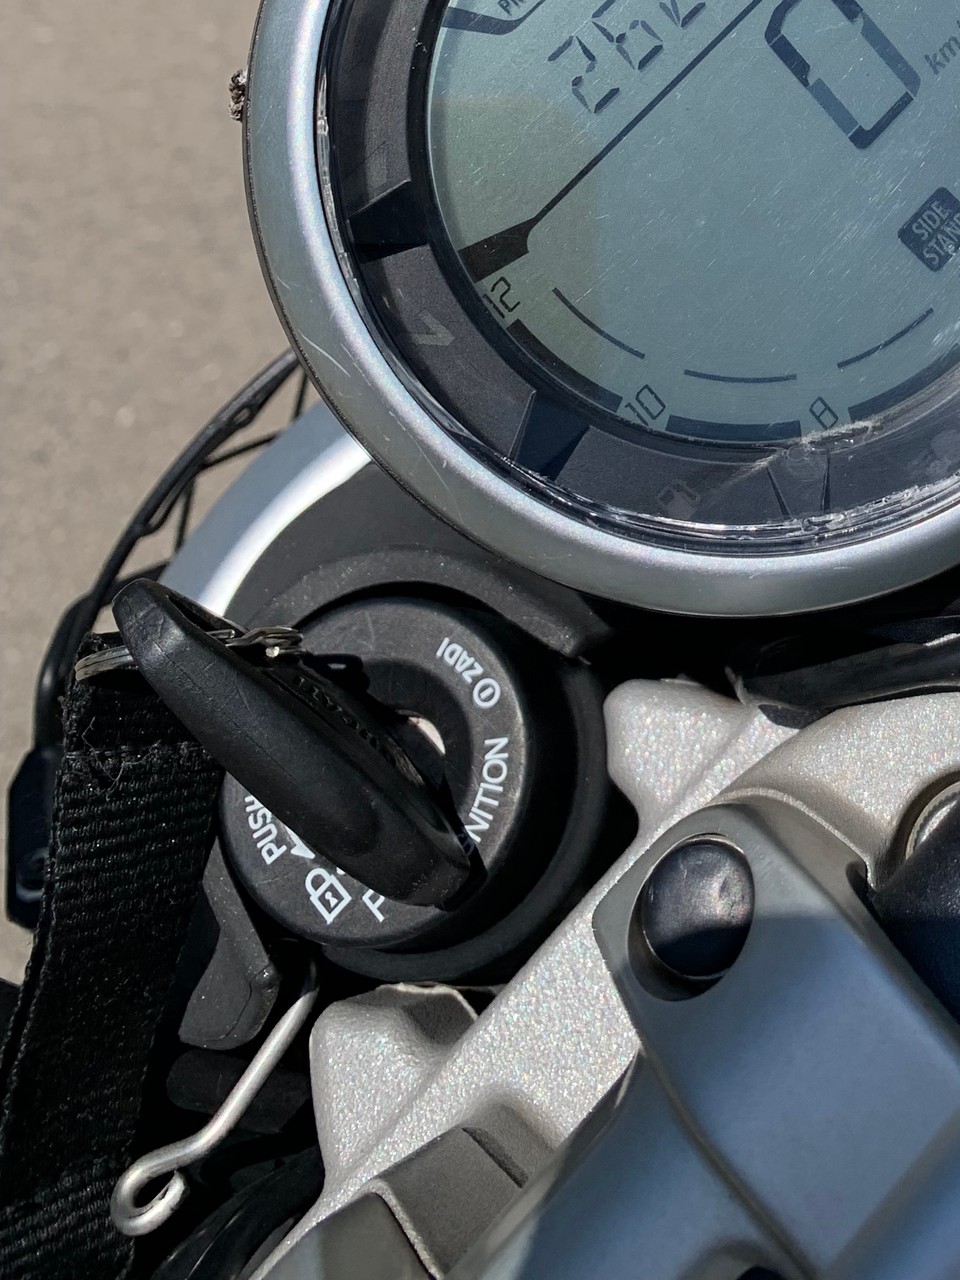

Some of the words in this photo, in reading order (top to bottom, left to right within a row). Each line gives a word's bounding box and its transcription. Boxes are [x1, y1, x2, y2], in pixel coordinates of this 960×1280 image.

[912, 200, 950, 239] SIDE
[482, 276, 521, 319] 12
[625, 385, 667, 427] 10
[809, 397, 839, 430] 8
[435, 637, 485, 685] ZADI
[459, 736, 509, 855] NITION
